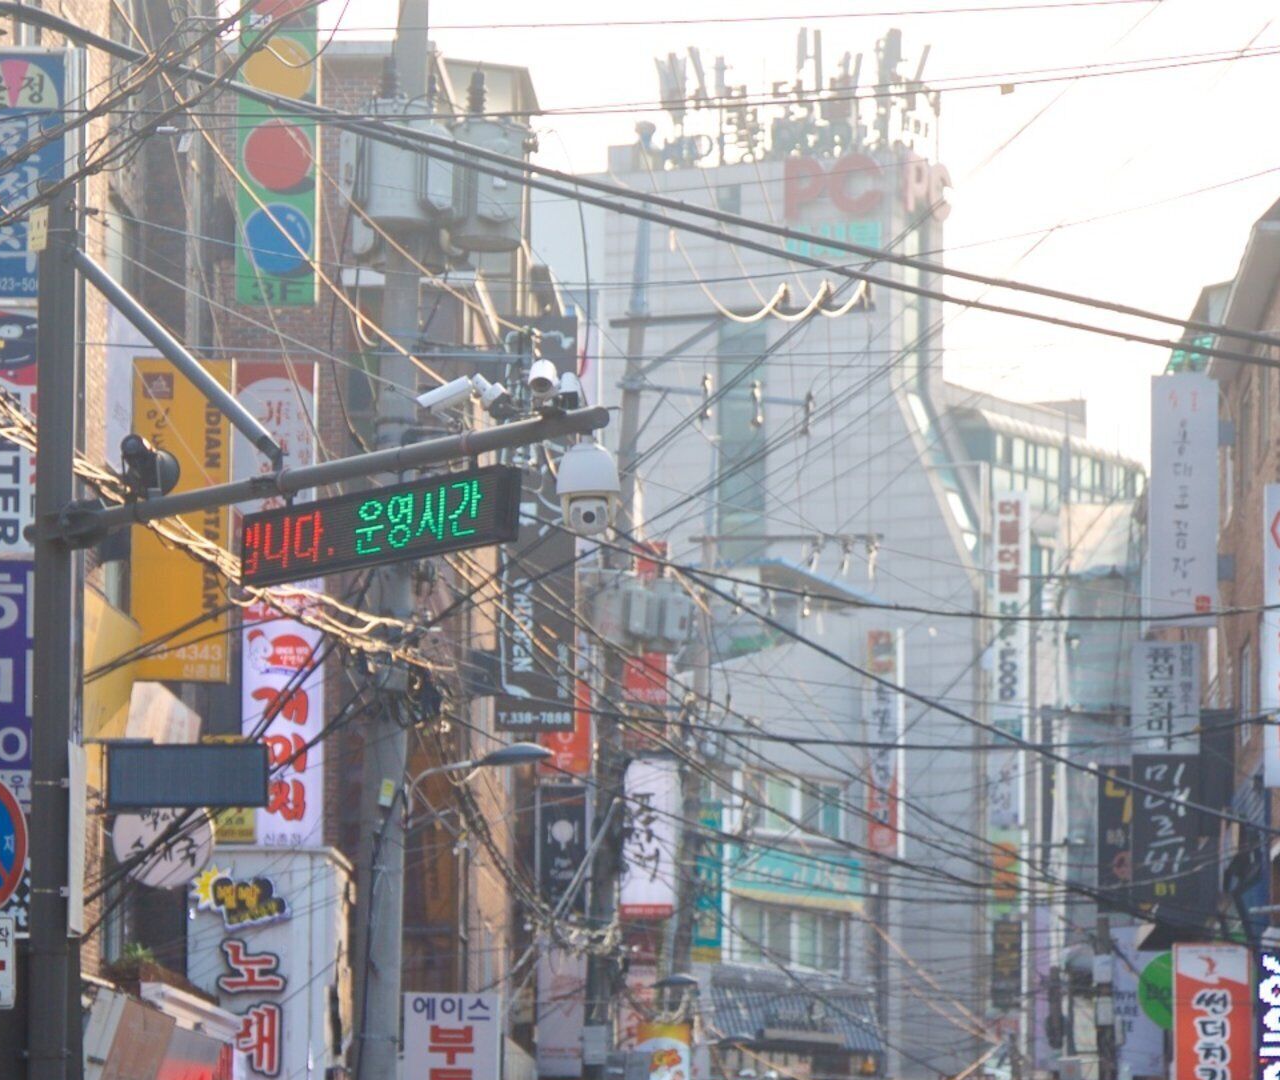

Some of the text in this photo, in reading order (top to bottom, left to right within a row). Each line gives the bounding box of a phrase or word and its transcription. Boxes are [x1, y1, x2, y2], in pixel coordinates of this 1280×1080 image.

[784, 153, 884, 220] PC
[355, 480, 482, 555] 운영시간
[220, 936, 286, 1073] 노래
[411, 995, 491, 1022] 에이스
